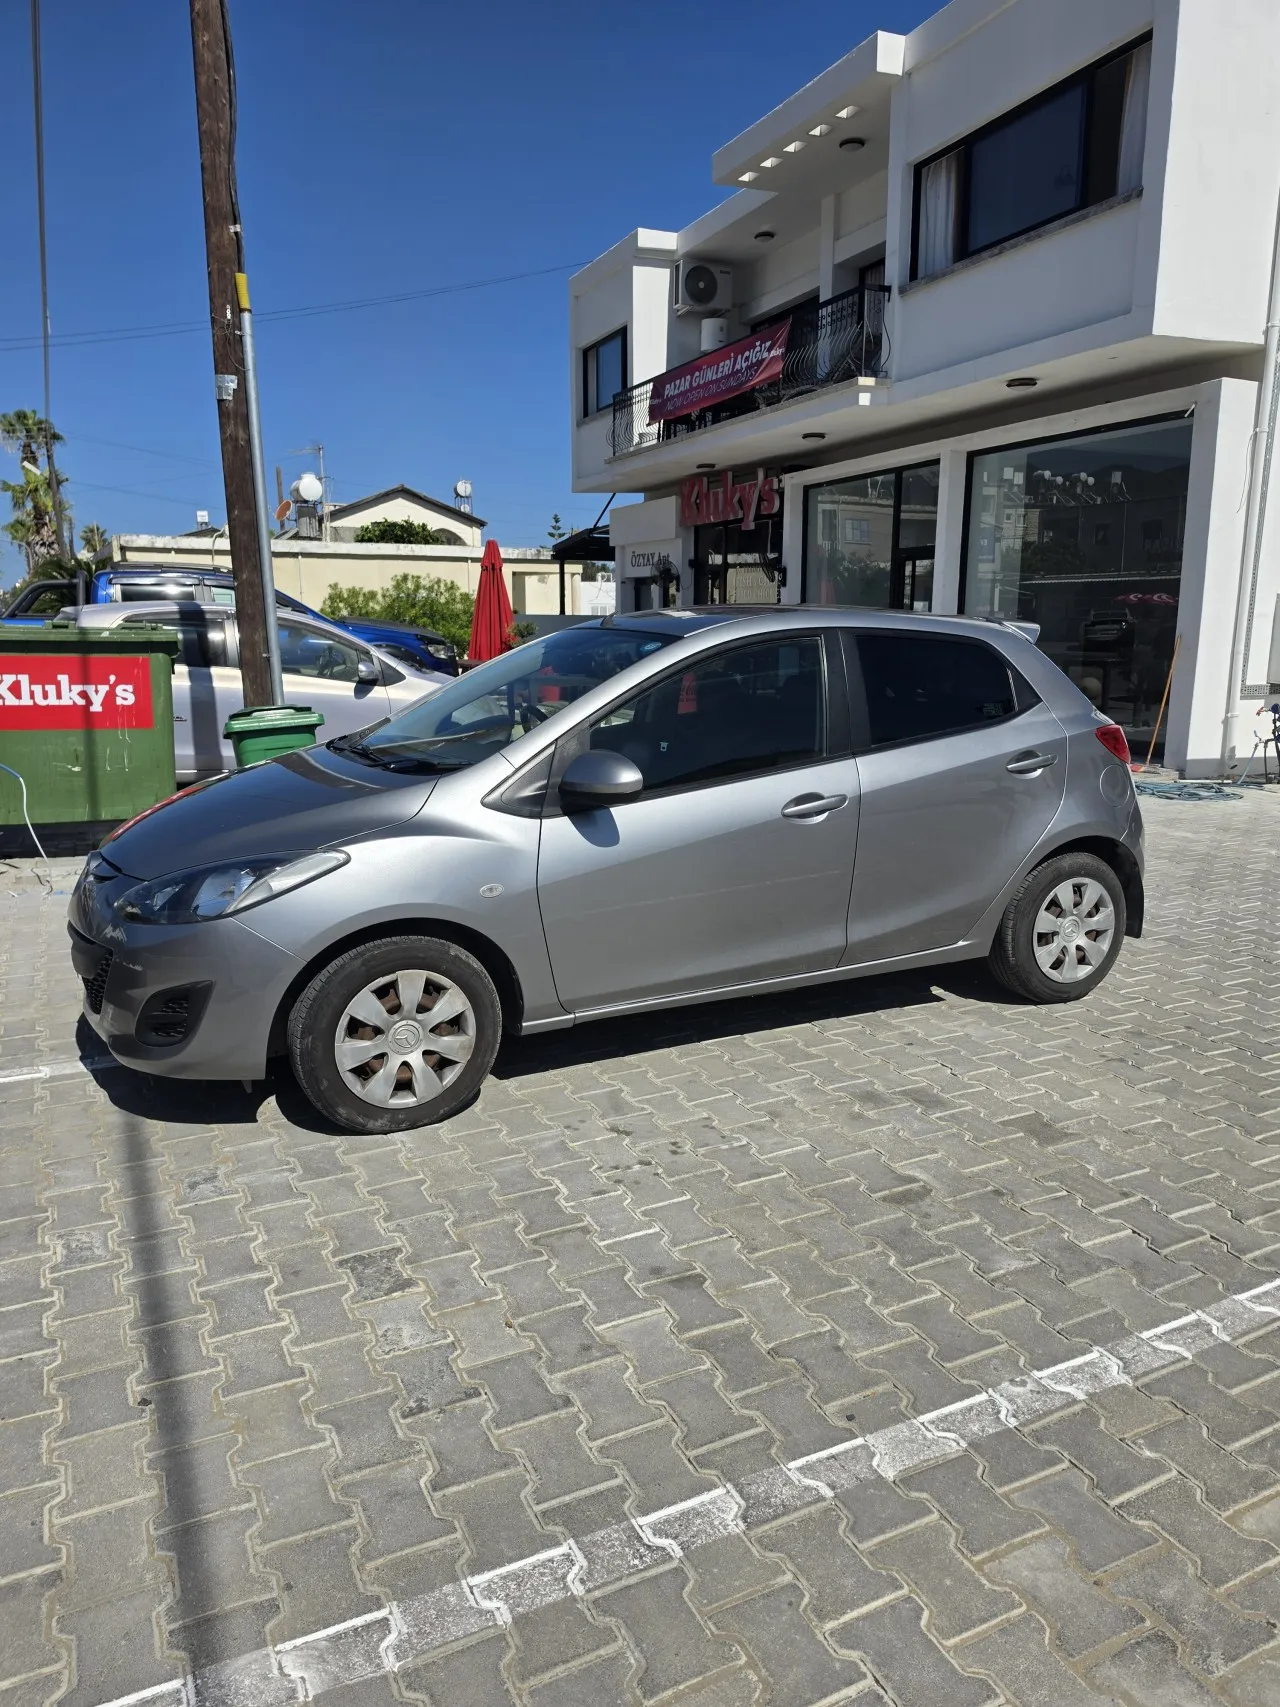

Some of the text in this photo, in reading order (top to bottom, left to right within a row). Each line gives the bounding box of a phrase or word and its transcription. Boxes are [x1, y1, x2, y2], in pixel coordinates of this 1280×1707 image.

[664, 340, 772, 399] PAZAR GÜNLERİ AÇIĞIZ
[665, 396, 684, 411] NOW
[684, 390, 704, 405] OPEN
[704, 384, 717, 397] ON
[717, 366, 757, 392] SUNDAYS
[631, 551, 655, 567] ÖZYAY
